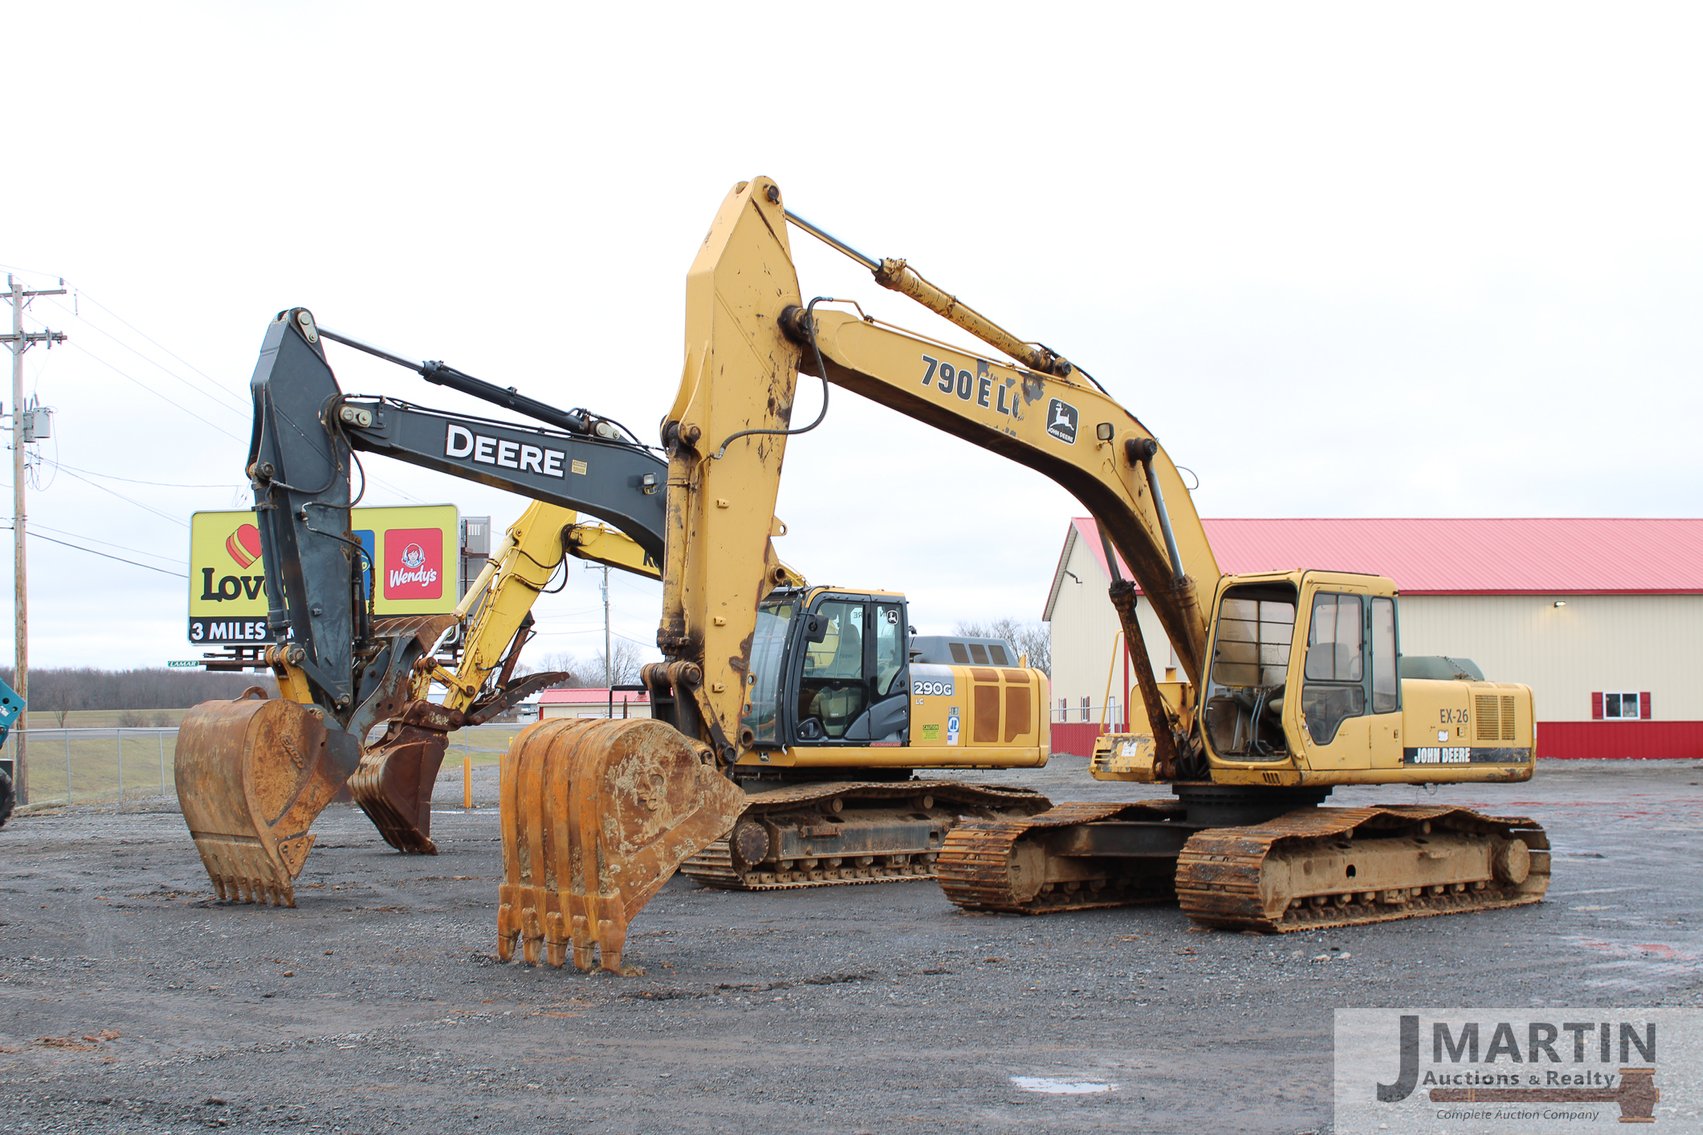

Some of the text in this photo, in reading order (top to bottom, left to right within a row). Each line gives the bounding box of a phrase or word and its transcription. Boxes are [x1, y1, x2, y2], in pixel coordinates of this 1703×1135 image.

[446, 423, 566, 478] DEERE
[200, 567, 269, 603] Lov
[389, 564, 438, 588] Wendy's
[191, 621, 204, 641] 3
[208, 621, 267, 641] MILES
[914, 681, 952, 696] 290G
[1439, 708, 1469, 723] EX-26
[1414, 747, 1471, 764] JOHN DEERE
